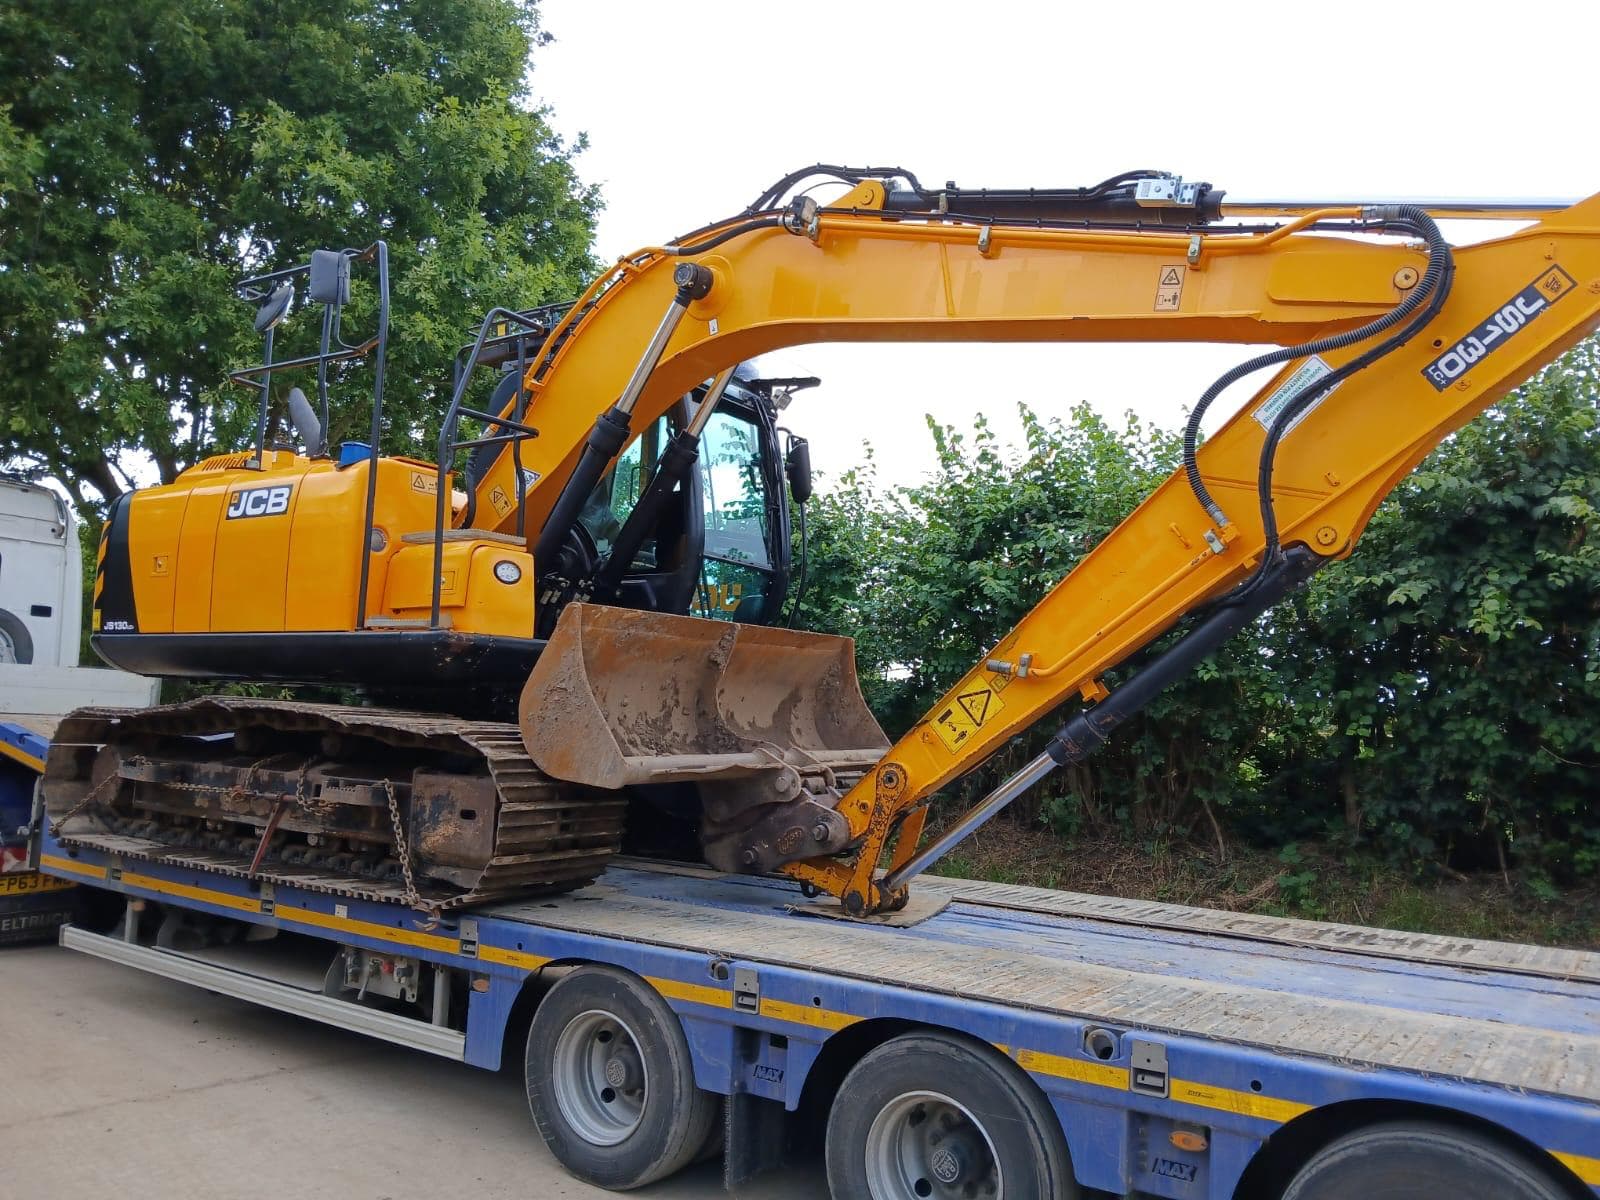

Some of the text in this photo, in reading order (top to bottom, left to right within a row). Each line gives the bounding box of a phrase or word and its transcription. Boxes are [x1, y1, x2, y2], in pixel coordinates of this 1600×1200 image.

[1437, 296, 1546, 378] JS130
[1428, 365, 1447, 385] LC+
[228, 487, 290, 518] JCB
[104, 621, 128, 630] JS130
[755, 1065, 783, 1082] MAX
[1155, 1159, 1195, 1182] MAX
